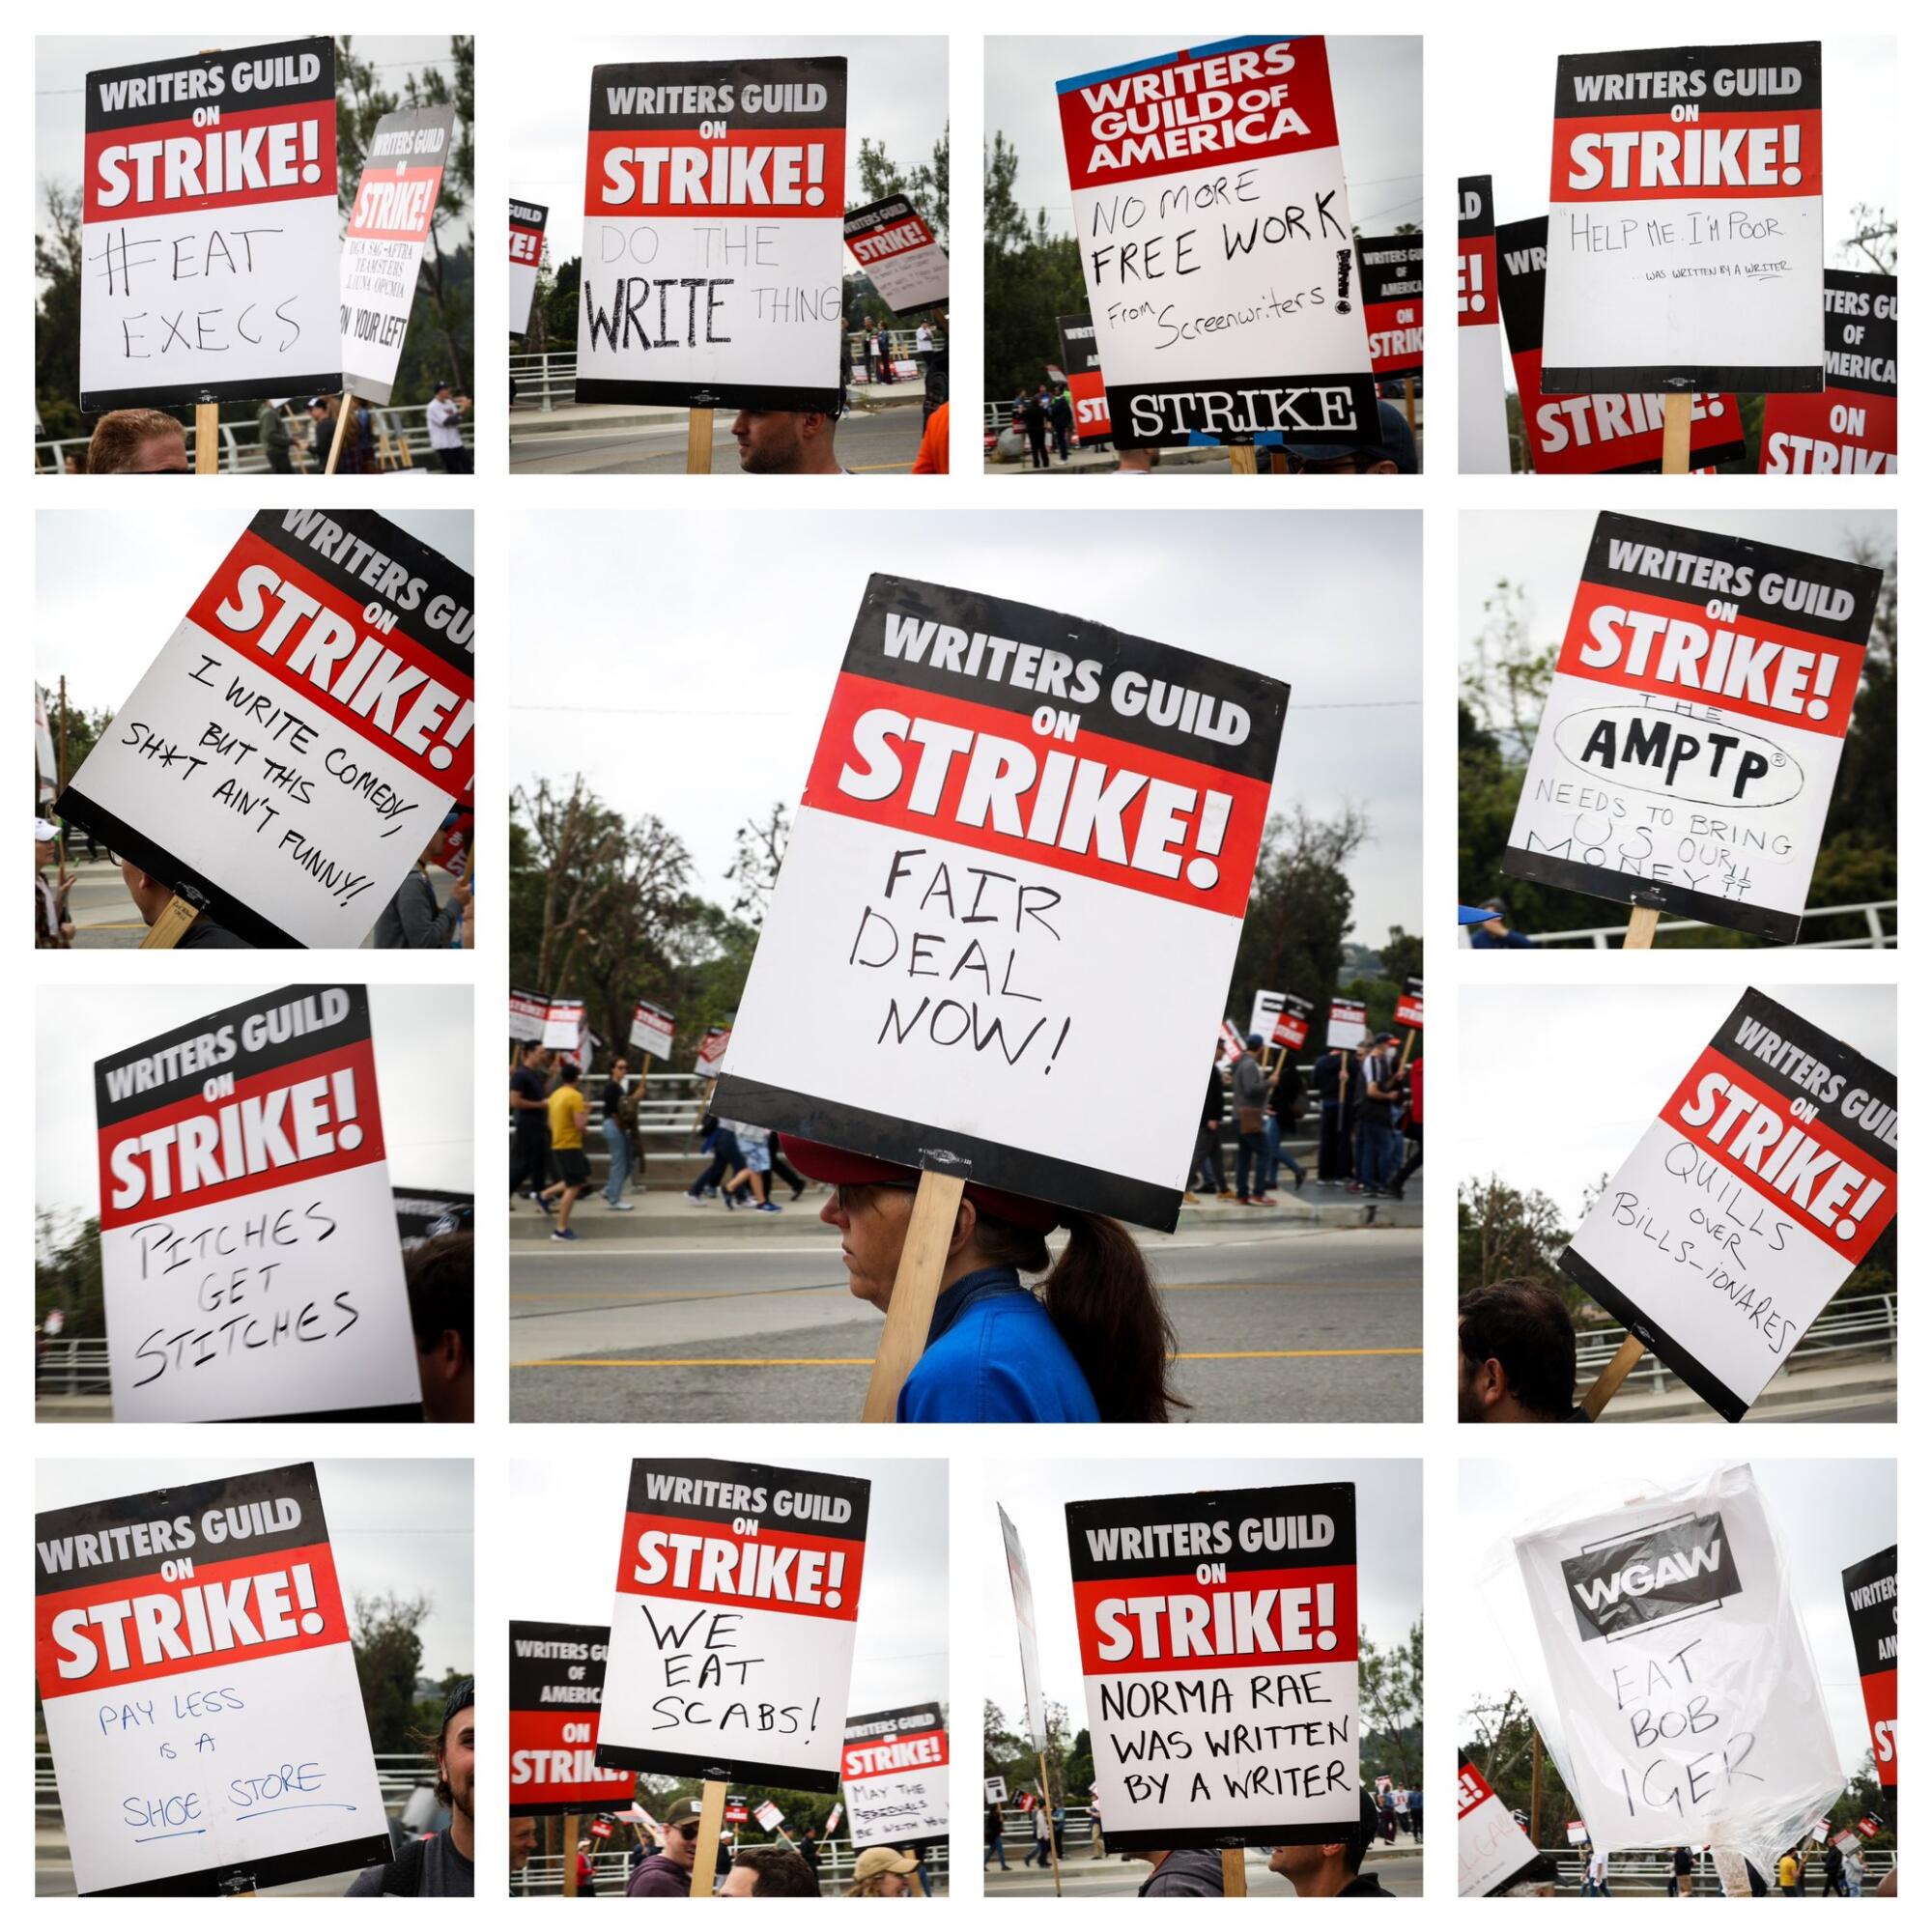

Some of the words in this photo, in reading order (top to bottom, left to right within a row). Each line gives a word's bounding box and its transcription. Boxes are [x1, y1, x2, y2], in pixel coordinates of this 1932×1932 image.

[99, 64, 226, 113] WRITERS
[231, 52, 321, 94] GUILD
[607, 85, 735, 115] WRITERS
[741, 83, 828, 113] GUILD
[1080, 43, 1296, 113] WRITERS
[1574, 69, 1707, 102] WRITERS
[1714, 67, 1803, 97] GUILD
[192, 106, 220, 128] ON
[699, 121, 726, 139] ON
[1092, 91, 1236, 142] GUILD
[1237, 83, 1289, 113] OF
[1670, 104, 1699, 123] ON
[97, 119, 321, 208] STRIKE!
[372, 130, 414, 156] WRITERS
[414, 128, 444, 154] GUILD
[1087, 108, 1311, 174] AMERICA
[1568, 124, 1803, 190] STRIKE!
[602, 143, 826, 207] STRIKE!
[355, 178, 434, 232] STRIKE!
[1093, 196, 1146, 237] NO
[1159, 169, 1262, 219] MORE
[89, 227, 283, 296] #EAT
[601, 226, 659, 264] DO
[694, 226, 780, 268] THE
[853, 221, 927, 261] STRIKE!
[1092, 230, 1202, 286] FREE
[1223, 190, 1347, 260] WORK
[1363, 250, 1407, 265] WRITERS
[1396, 267, 1406, 277] OF
[1672, 266, 1717, 279] WRITTEN
[1719, 265, 1732, 276] BY
[1734, 265, 1742, 275] A
[1745, 261, 1792, 273] WRITER
[123, 296, 299, 357] EXECS
[354, 308, 381, 343] YOUR
[379, 314, 407, 349] LEFT
[583, 277, 735, 354] WRITE
[751, 287, 841, 323] THING
[1396, 308, 1414, 324] ON
[1843, 325, 1865, 345] OF
[1130, 386, 1358, 438] STRIKE
[1830, 404, 1865, 437] ON
[281, 509, 429, 611] WRITERS
[1607, 538, 1754, 597] WRITERS
[1758, 574, 1855, 621] GUILD
[362, 601, 399, 635] ON
[1706, 600, 1738, 624] ON
[215, 564, 474, 771] STRIKE!
[883, 612, 1103, 704] WRITERS
[1110, 671, 1252, 746] GUILD
[1578, 605, 1840, 721] STRIKE!
[188, 654, 221, 687] I
[225, 676, 319, 754] WRITE
[1031, 705, 1081, 743] ON
[1639, 694, 1722, 721] THE
[199, 722, 258, 765] BUT
[263, 756, 316, 805] THIS
[213, 779, 279, 832] AIN'T
[838, 709, 1234, 890] STRIKE!
[1535, 779, 1627, 817] NEEDS
[1646, 807, 1673, 826] TO
[1690, 814, 1792, 855] BRING
[1526, 830, 1710, 891] MONEY
[1573, 812, 1653, 859] US
[1678, 838, 1732, 868] OUR
[884, 849, 1062, 940] FAIR
[850, 906, 1042, 1002] DEAL
[105, 1025, 238, 1102] WRITERS
[242, 987, 351, 1053] GUILD
[877, 996, 1071, 1075] NOW!
[1734, 1015, 1846, 1104] WRITERS
[203, 1072, 235, 1102] ON
[1789, 1097, 1819, 1124] ON
[110, 1067, 364, 1209] STRIKE!
[1679, 1072, 1886, 1241] STRIKE!
[130, 1202, 336, 1280] PITCHES
[1690, 1208, 1747, 1271] OVER
[198, 1263, 281, 1312] GET
[131, 1291, 359, 1389] STITCHES
[646, 1473, 768, 1514] WRITERS
[774, 1490, 852, 1523] GUILD
[36, 1517, 196, 1574] WRITERS
[201, 1497, 302, 1544] GUILD
[732, 1518, 758, 1536] ON
[1086, 1520, 1232, 1562] WRITERS
[1238, 1515, 1336, 1553] GUILD
[160, 1557, 194, 1582] ON
[634, 1530, 846, 1609] STRIKE!
[1196, 1563, 1226, 1585] ON
[1574, 1539, 1721, 1610] WGAW
[51, 1563, 325, 1679] STRIKE!
[641, 1605, 744, 1651] WE
[1094, 1582, 1338, 1662] STRIKE!
[515, 1640, 589, 1661] WRITERS
[568, 1666, 586, 1680] OF
[665, 1654, 765, 1688] EAT
[1613, 1638, 1703, 1711] EAT
[99, 1700, 154, 1735] PAY
[175, 1688, 245, 1719] LESS
[651, 1696, 820, 1745] SCABS!
[898, 1714, 935, 1730] GUILD
[1101, 1678, 1234, 1721] NORMA
[1251, 1671, 1332, 1709] RAE
[1630, 1695, 1719, 1748] BOB
[195, 1733, 215, 1752] A
[562, 1723, 590, 1743] ON
[846, 1737, 942, 1776] STRIKE!
[1111, 1731, 1192, 1764] WAS
[1205, 1715, 1350, 1757] WRITTEN
[123, 1792, 202, 1827] SHOE
[228, 1763, 327, 1806] STORE
[853, 1785, 888, 1803] MAY
[896, 1784, 925, 1795] THE
[1123, 1773, 1169, 1804] BY
[1190, 1773, 1211, 1803] A
[1223, 1760, 1351, 1799] WRITER
[1621, 1732, 1765, 1818] IGER
